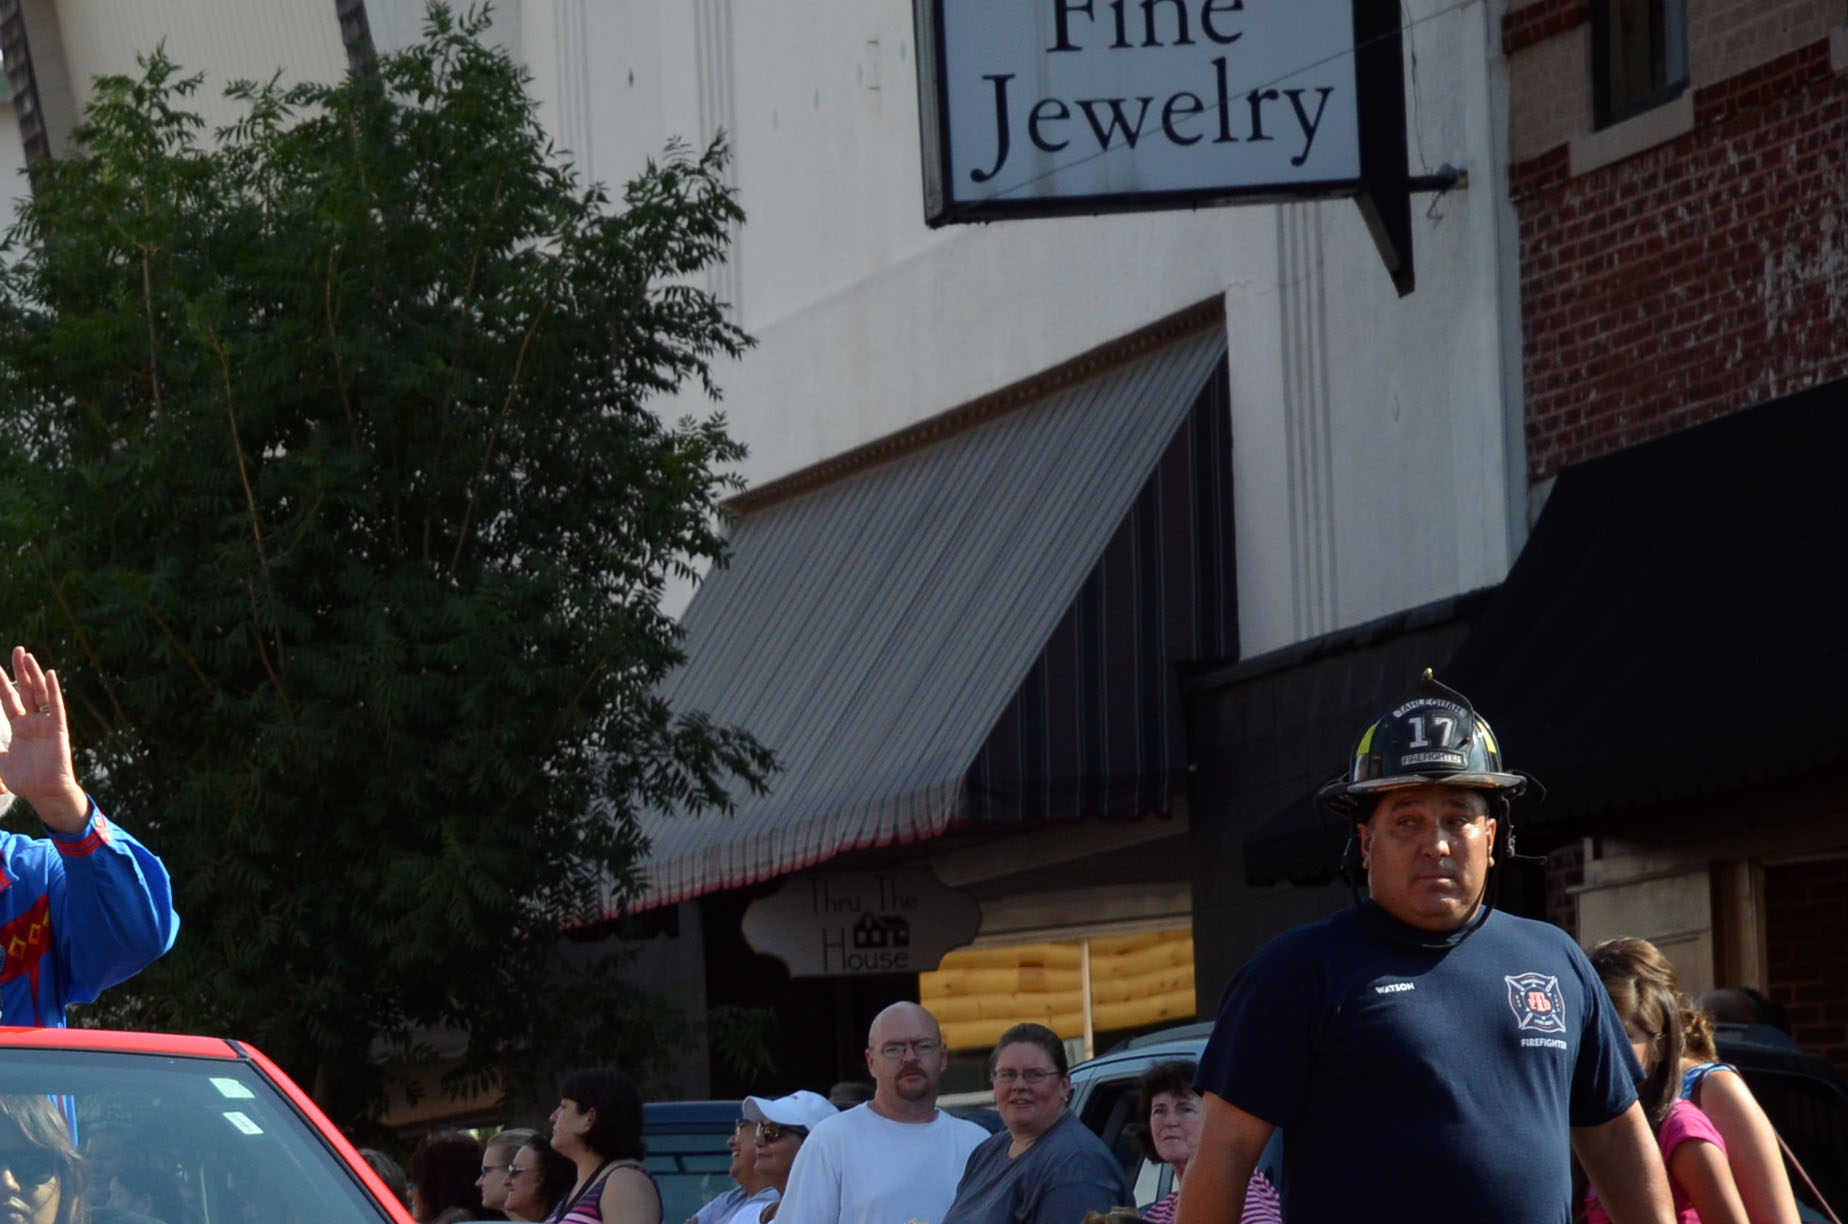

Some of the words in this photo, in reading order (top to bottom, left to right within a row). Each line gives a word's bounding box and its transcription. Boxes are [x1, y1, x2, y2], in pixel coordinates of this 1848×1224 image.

[1046, 0, 1244, 53] Fine
[970, 56, 1334, 183] Jewelry
[1408, 716, 1454, 748] 17
[1402, 751, 1463, 766] FIREFIGHTER
[807, 876, 862, 914] Thru
[874, 871, 919, 911] The
[821, 927, 910, 972] House
[1375, 982, 1415, 994] WATSON
